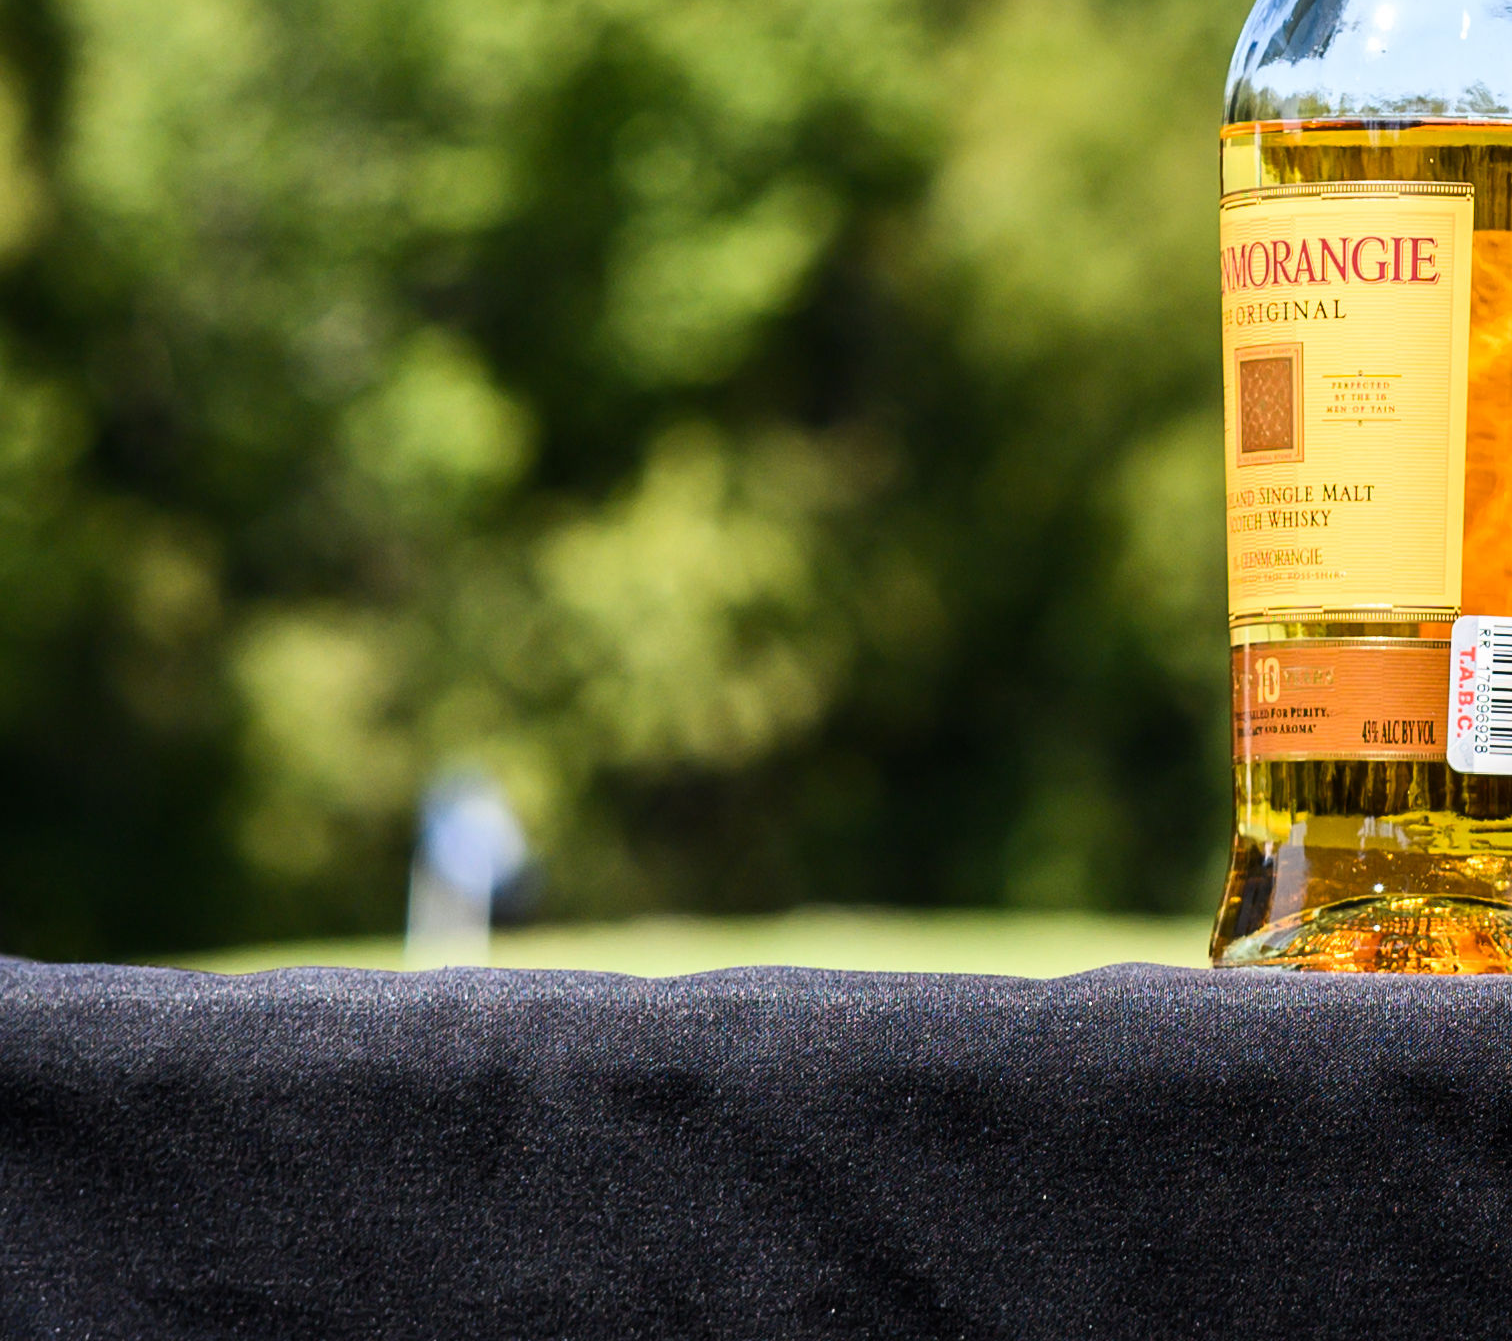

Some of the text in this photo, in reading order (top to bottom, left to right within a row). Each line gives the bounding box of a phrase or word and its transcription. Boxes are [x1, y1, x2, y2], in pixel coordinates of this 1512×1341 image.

[1235, 300, 1347, 325] ORIGINAL
[1352, 393, 1370, 401] THE
[1259, 485, 1314, 505] SINGLE
[1322, 484, 1374, 502] MALT
[1268, 510, 1331, 528] WHISKY
[1255, 657, 1280, 703] 10
[1456, 646, 1476, 738] T.A.B.C.
[1271, 708, 1288, 718] FOR
[1291, 707, 1330, 718] PURITY,
[1475, 666, 1491, 754] 176096928
[1362, 720, 1436, 745] 43% ALC BY VOL
